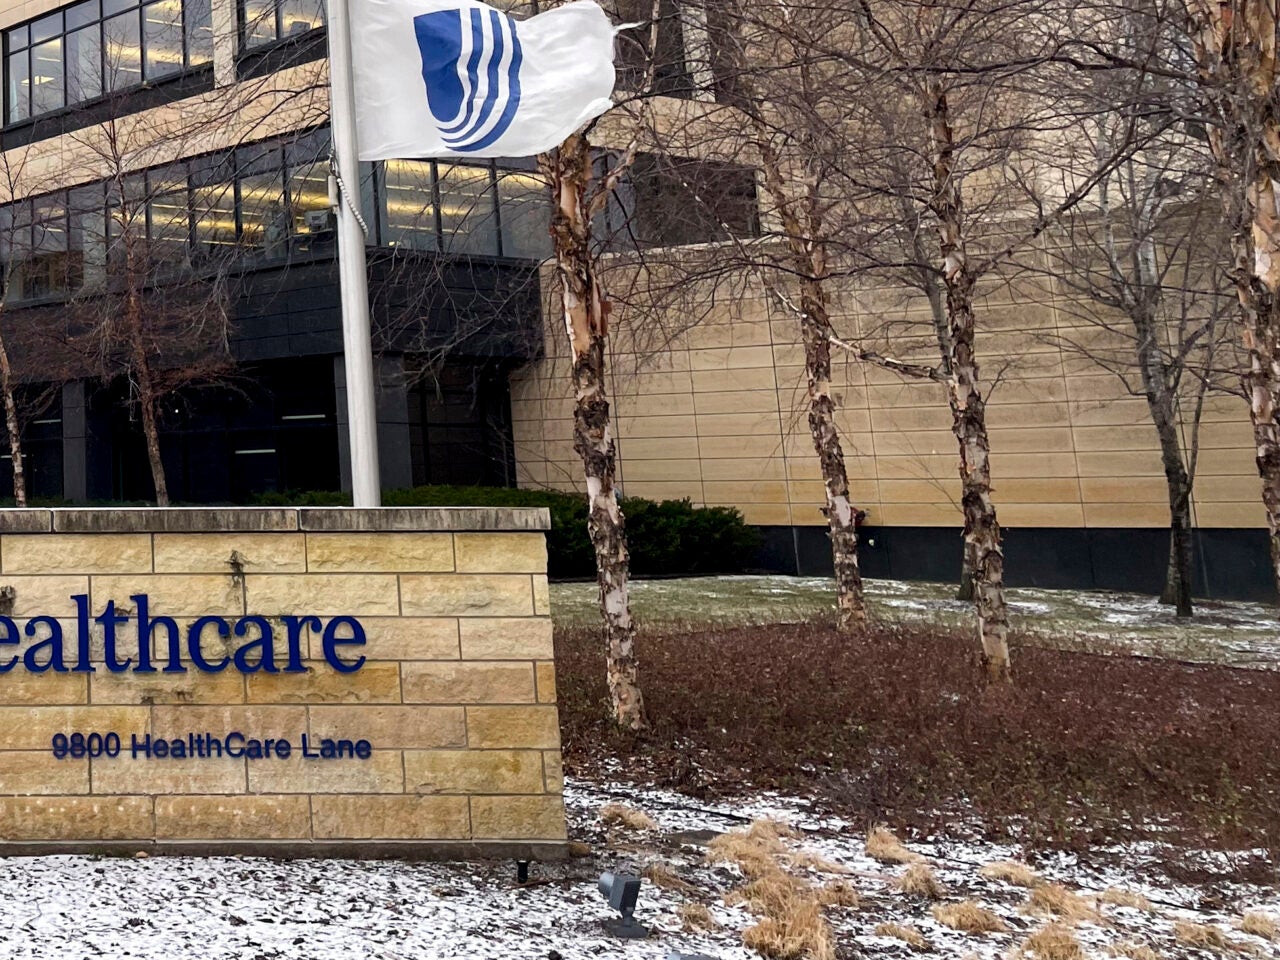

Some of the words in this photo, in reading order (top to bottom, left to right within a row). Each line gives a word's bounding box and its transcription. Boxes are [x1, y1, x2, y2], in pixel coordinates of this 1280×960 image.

[52, 732, 122, 760] 9800
[131, 732, 291, 759] HealthCare
[300, 732, 372, 759] Lane
